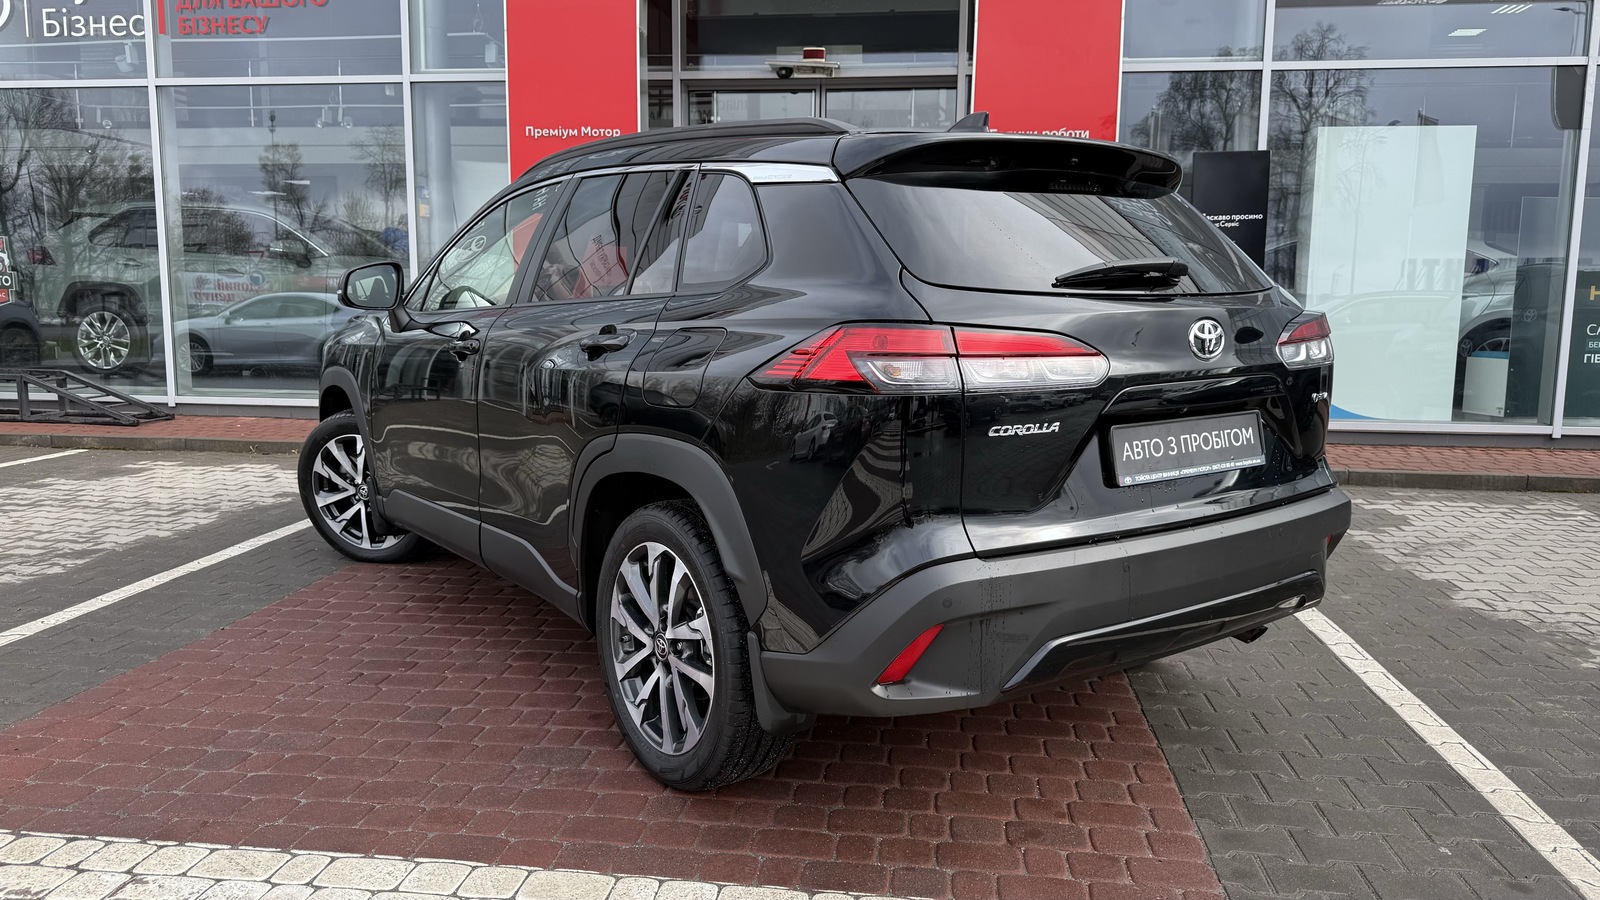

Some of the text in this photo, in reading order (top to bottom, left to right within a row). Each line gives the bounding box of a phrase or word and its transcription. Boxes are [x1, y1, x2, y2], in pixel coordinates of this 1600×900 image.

[42, 7, 146, 37] Бізнес
[177, 15, 268, 35] БІЗНЕСУ
[525, 125, 621, 139] Преміум Мотор
[1231, 213, 1264, 222] просимо
[988, 421, 1060, 437] COROLLA
[1122, 438, 1164, 462] АВТО
[1180, 426, 1255, 454] ПРОБІГОМ
